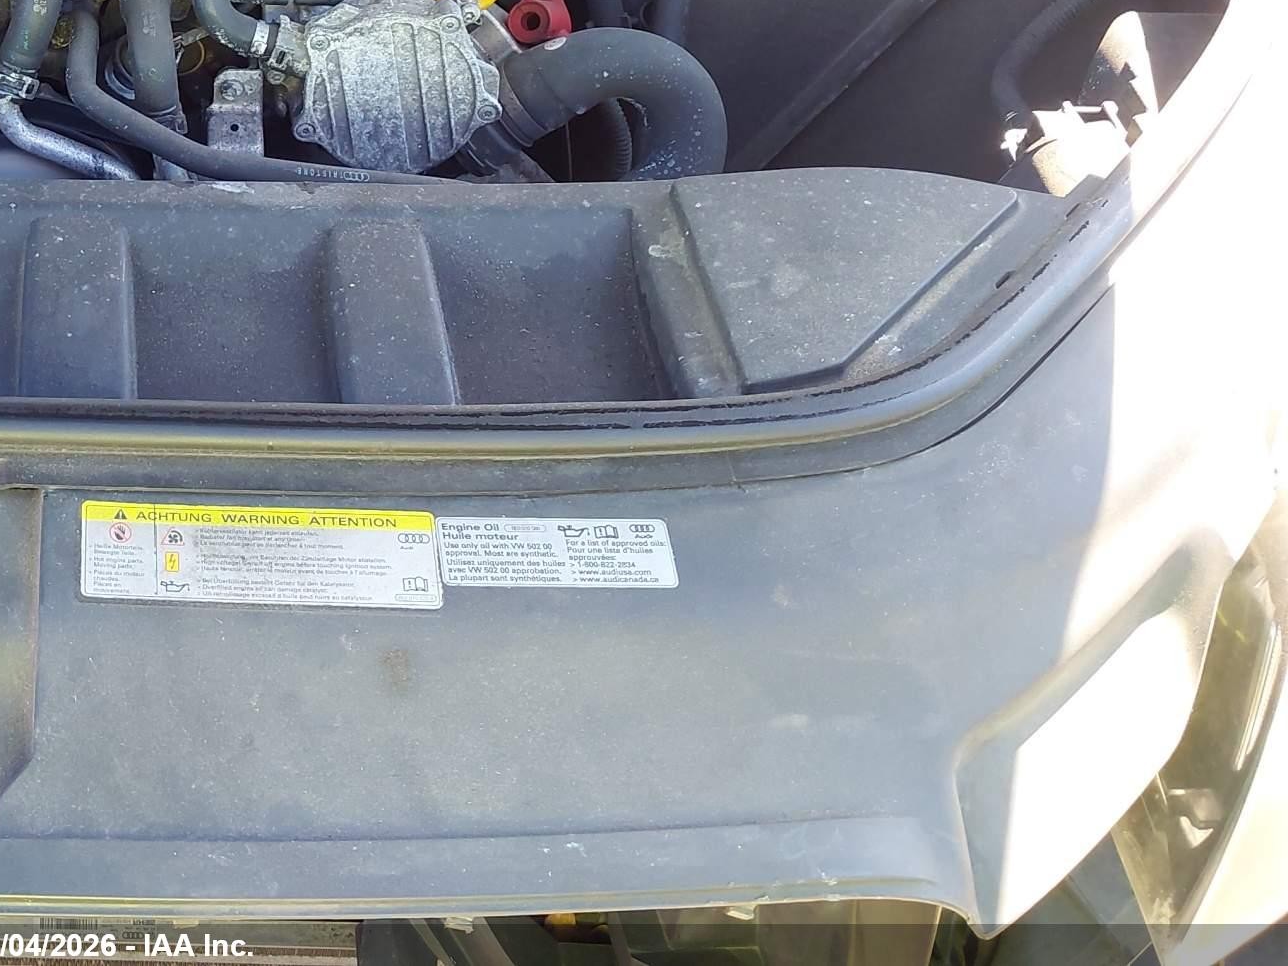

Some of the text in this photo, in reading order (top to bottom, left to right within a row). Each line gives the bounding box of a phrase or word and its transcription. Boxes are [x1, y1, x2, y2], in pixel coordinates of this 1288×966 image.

[136, 511, 397, 528] ACHTUNG WARNING ATTENTION
[441, 523, 481, 533] Engine
[484, 523, 500, 531] Oil
[443, 532, 472, 540] Huile
[461, 542, 478, 550] only
[612, 540, 649, 548] approved
[520, 550, 559, 558] synthetic.
[460, 574, 489, 582] plupart
